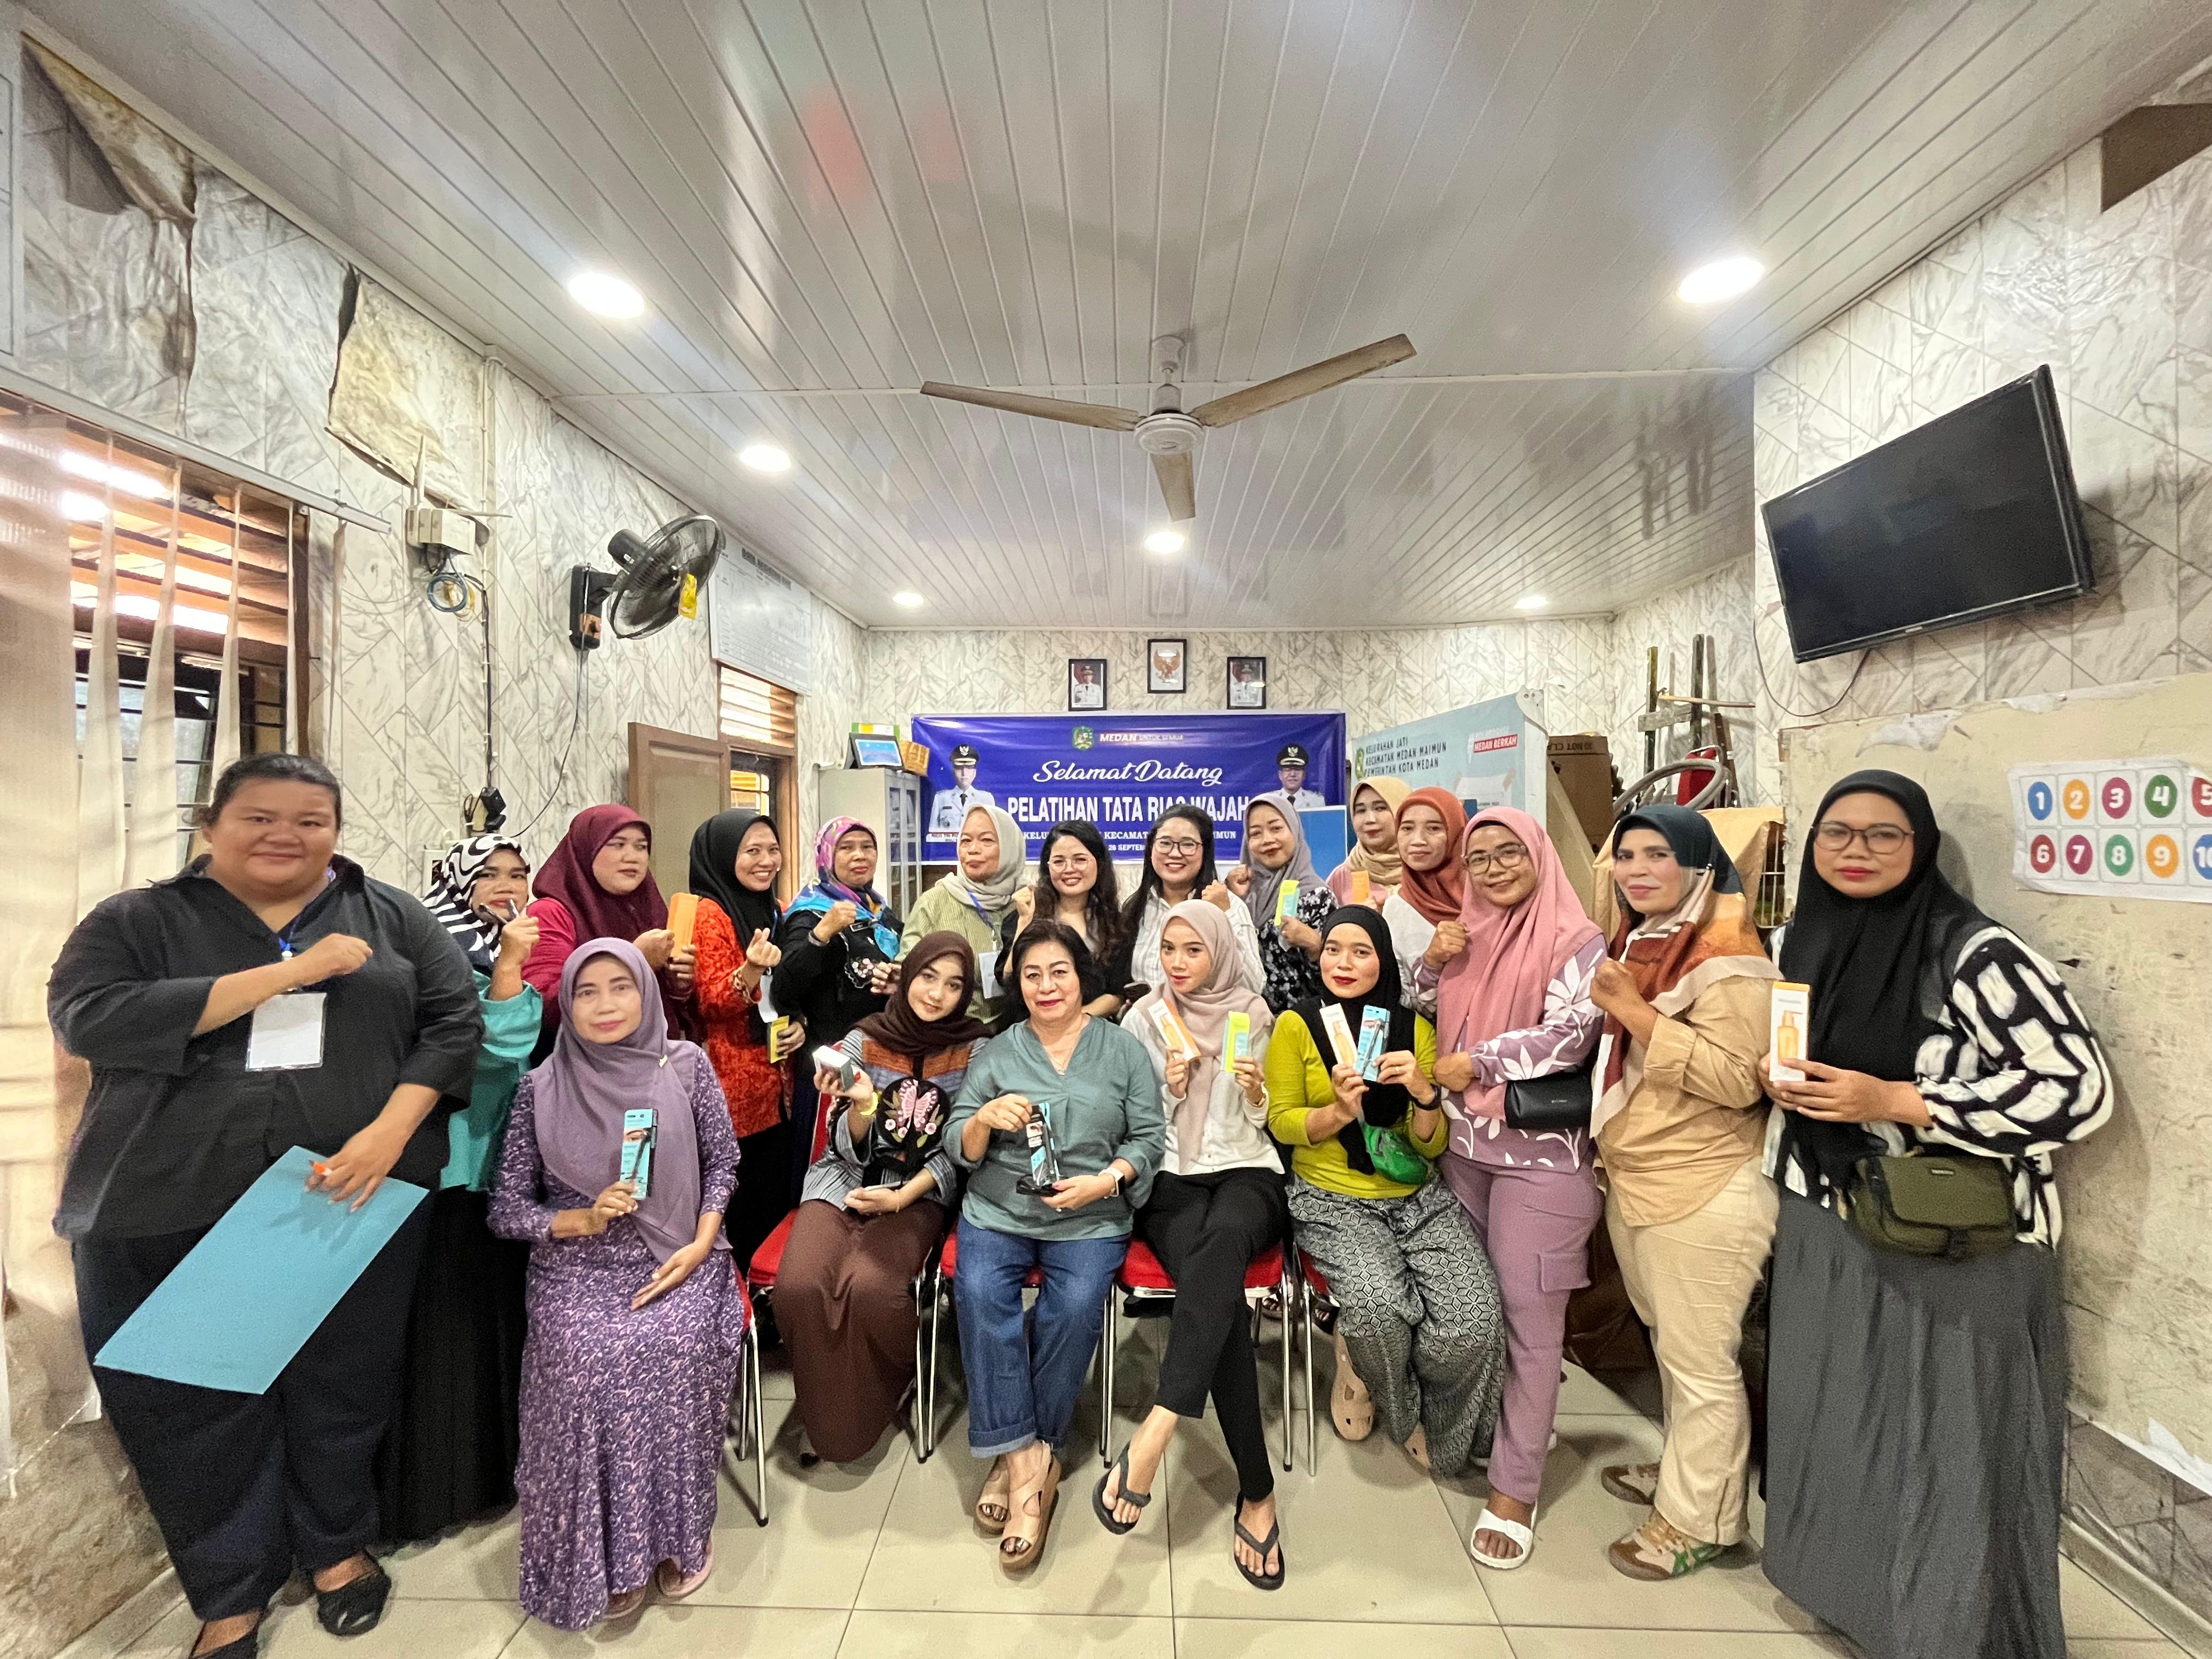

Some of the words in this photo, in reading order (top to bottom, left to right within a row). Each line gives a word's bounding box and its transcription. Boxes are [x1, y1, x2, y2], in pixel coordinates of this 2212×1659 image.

[1100, 733, 1137, 742] MEDAN
[1396, 737, 1408, 748] JATI
[1474, 740, 1493, 752] MEDAN
[1493, 735, 1517, 748] BERKAH
[1397, 748, 1417, 760] MEDAN
[1419, 742, 1446, 757] MAIMUN
[1032, 760, 1137, 782] Selamat
[1134, 759, 1223, 787] Datang
[1398, 761, 1414, 773] KOTA
[1417, 758, 1438, 771] MEDAN
[2035, 792, 2044, 810] 1
[2069, 789, 2084, 810] 2
[2109, 788, 2125, 809] 3
[2152, 786, 2170, 806] 4
[2200, 783, 2212, 806] 5
[1007, 797, 1098, 822] PELATIHAN
[1102, 797, 1143, 822] TATA
[1104, 831, 1149, 839] KECAMAT
[2036, 844, 2050, 864] 6
[2072, 845, 2085, 865] 7
[2111, 845, 2126, 866] 8
[2153, 846, 2171, 867] 9
